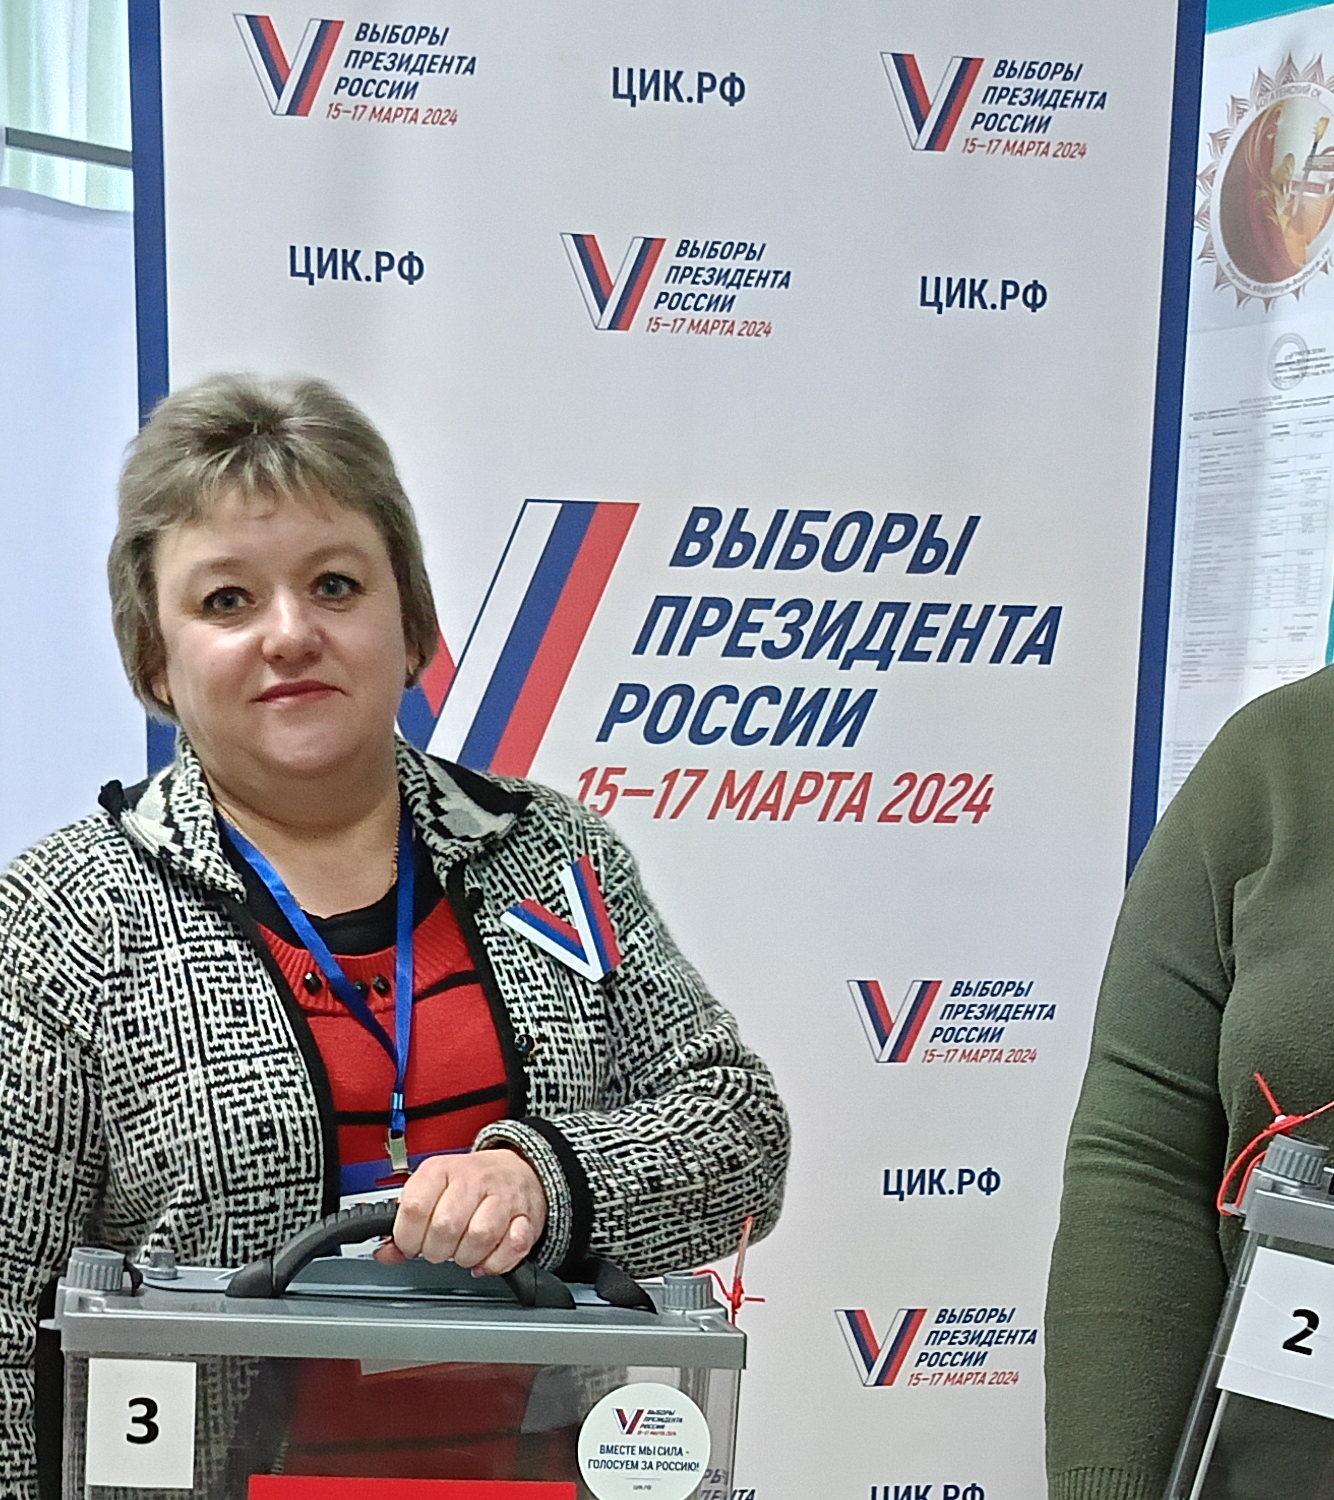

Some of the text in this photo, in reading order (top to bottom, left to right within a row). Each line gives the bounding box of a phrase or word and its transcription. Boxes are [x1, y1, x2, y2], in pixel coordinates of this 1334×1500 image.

[355, 23, 449, 46] ВЫБОРЫ
[344, 50, 476, 75] ПРЕЗИДЕНТА
[993, 60, 1083, 81] ВЫБОРЫ
[334, 77, 419, 100] РОССИИ
[613, 67, 745, 107] ЦИК.РФ
[982, 86, 1107, 110] ПРЕЗИДЕНТА
[368, 106, 419, 124] МАРТА
[422, 108, 457, 125] 2024
[971, 112, 1052, 133] РОССИИ
[1002, 140, 1050, 157] МАРТА
[1052, 142, 1086, 158] 2024
[675, 240, 766, 261] ВЫБОРЫ
[290, 246, 424, 285] ЦИК.РФ
[665, 266, 791, 290] ПРЕЗИДЕНТА
[654, 292, 736, 312] РОССИИ
[920, 276, 1047, 314] ЦИК.РФ
[687, 319, 735, 335] МАРТА
[737, 321, 772, 337] 2024
[669, 506, 981, 575] ВЫБОРЫ
[632, 595, 1062, 671] ПРЕЗИДЕНТА
[596, 683, 878, 747] РОССИИ
[707, 770, 873, 822] МАРТА
[877, 772, 994, 824] 2024
[950, 981, 1033, 997] ВЫБОРЫ
[940, 1004, 1056, 1022] ПРЕЗИДЕНТА
[929, 1027, 1005, 1043] РОССИИ
[958, 1049, 1003, 1062] МАРТА
[1005, 1049, 1037, 1063] 2024
[883, 1168, 1000, 1201] ЦИК.РФ
[935, 1308, 1016, 1324] ВЫБОРЫ
[925, 1330, 1037, 1347] ПРЕЗИДЕНТА
[1283, 1309, 1319, 1355] 2
[915, 1351, 988, 1367] РОССИИ
[943, 1372, 986, 1385] МАРТА
[988, 1372, 1019, 1385] 2024
[127, 1398, 159, 1444] 3
[600, 1445, 636, 1455] ВМЕСТЕ
[639, 1446, 656, 1455] МЫ
[657, 1446, 683, 1456] СИЛА
[588, 1459, 699, 1471] ГОЛОСУЕМ ЗА РОССИЮ!
